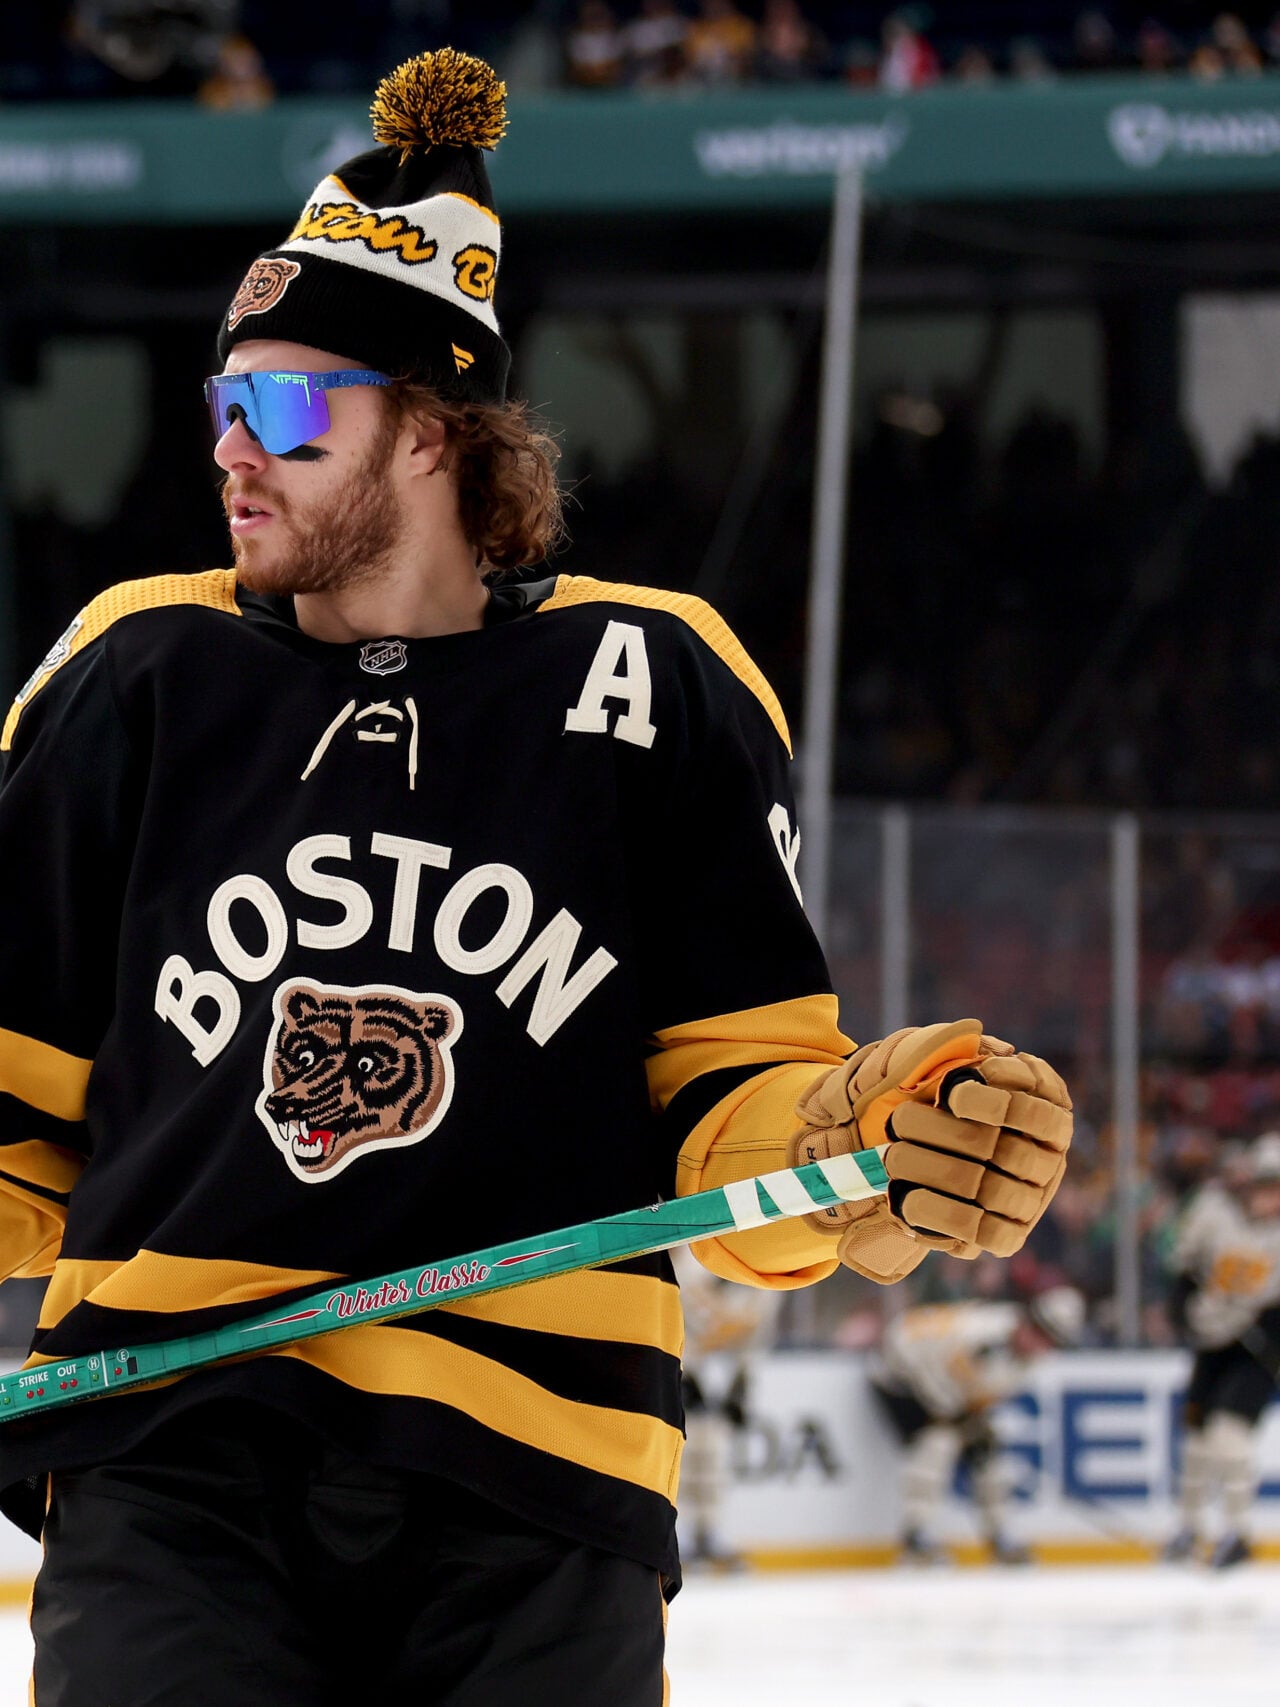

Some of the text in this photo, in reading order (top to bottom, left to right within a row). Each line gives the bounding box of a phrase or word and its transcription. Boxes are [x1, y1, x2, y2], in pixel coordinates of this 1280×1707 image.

[370, 648, 398, 667] NHL
[564, 620, 657, 749] A
[154, 831, 619, 1068] BOSTON
[325, 1260, 493, 1319] Winter Classic
[18, 1371, 49, 1388] STRIKE
[57, 1364, 77, 1378] OUT
